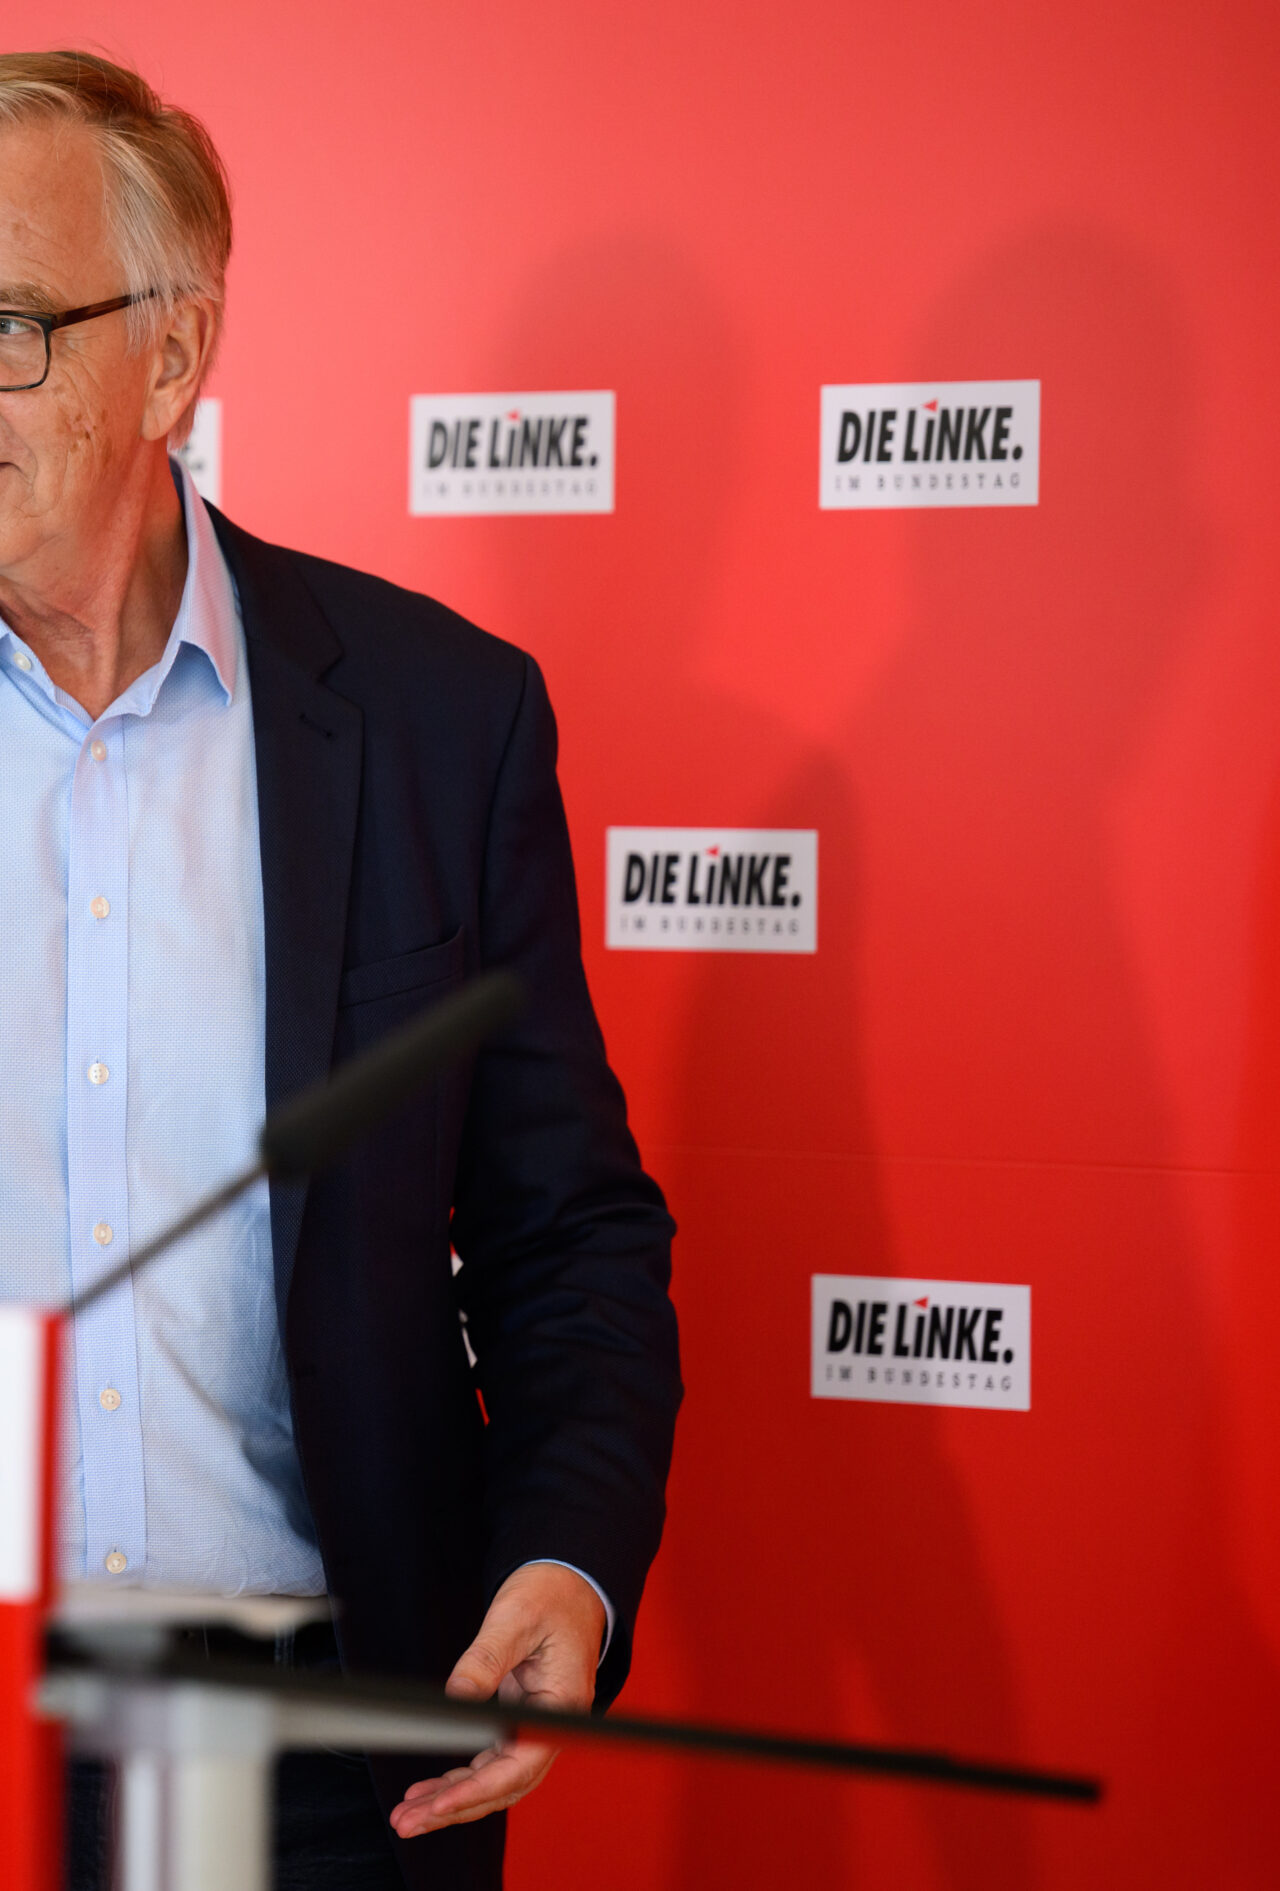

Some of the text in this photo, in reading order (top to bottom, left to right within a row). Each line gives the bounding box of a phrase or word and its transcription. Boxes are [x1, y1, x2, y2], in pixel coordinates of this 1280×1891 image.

[427, 418, 481, 469] DIE
[837, 409, 897, 463] DIE
[835, 472, 1021, 491] IM BUNDESTAG
[623, 853, 679, 905] DIE
[827, 1299, 887, 1355] DIE
[825, 1364, 1012, 1392] IM BUNDESTAG
